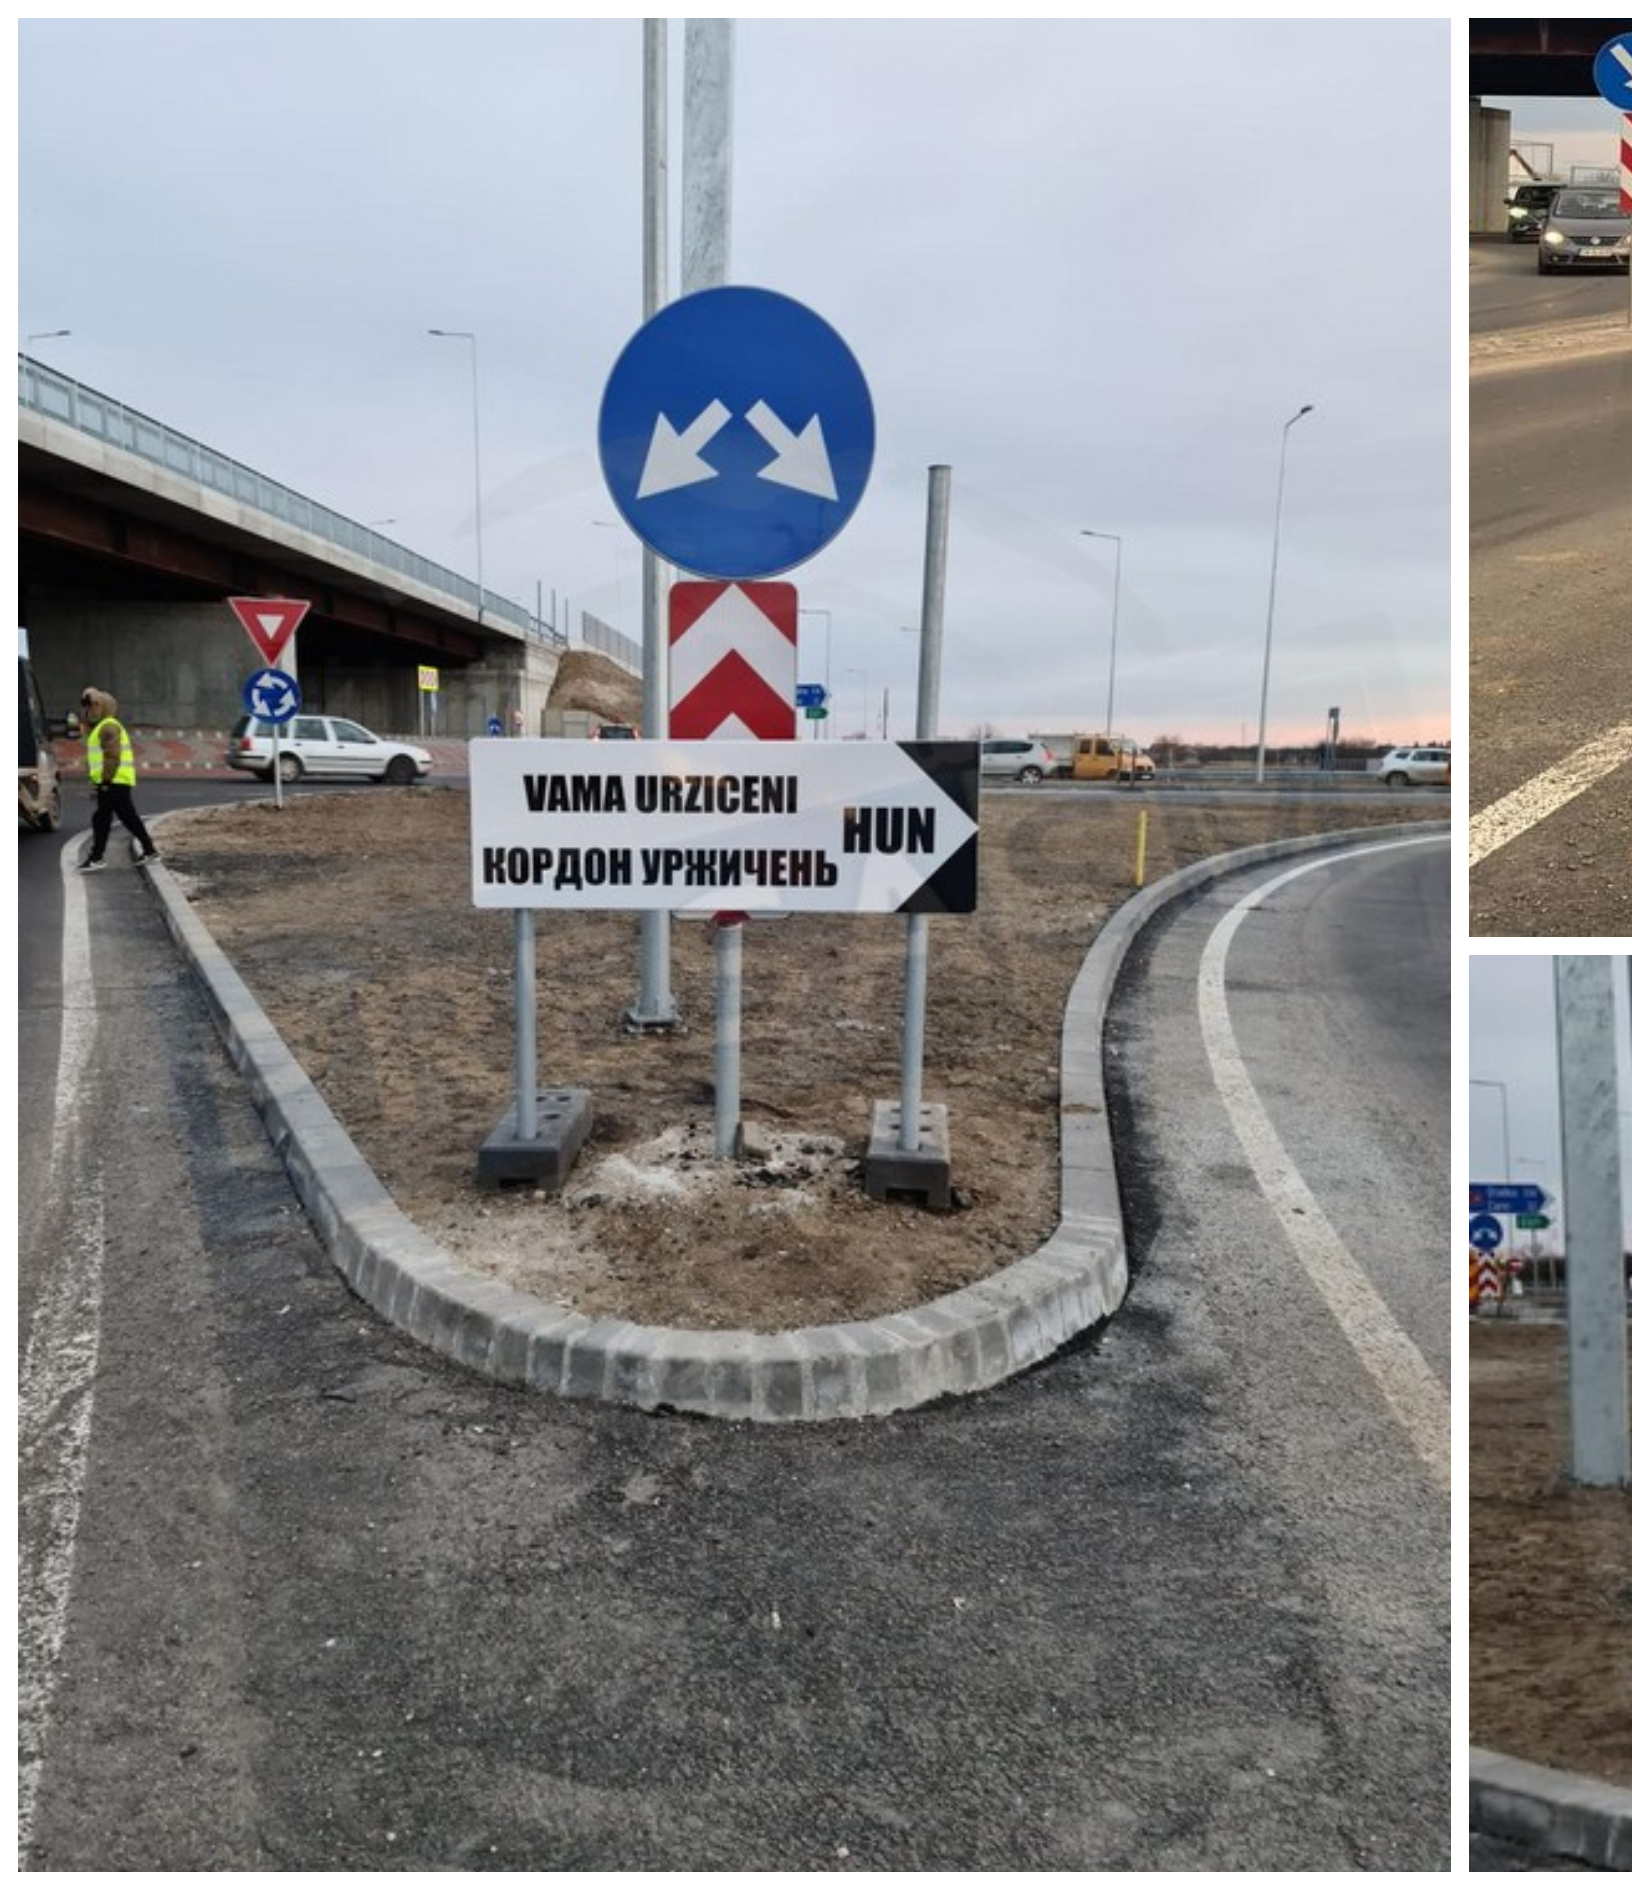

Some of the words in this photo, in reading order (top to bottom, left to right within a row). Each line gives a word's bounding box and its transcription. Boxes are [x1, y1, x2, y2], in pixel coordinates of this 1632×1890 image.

[523, 775, 626, 812] VAMA
[635, 776, 797, 814] URZICENI
[844, 807, 935, 854] HUN
[484, 848, 631, 890] КОРДОН
[641, 849, 837, 886] УРЖИЧЕНЬ
